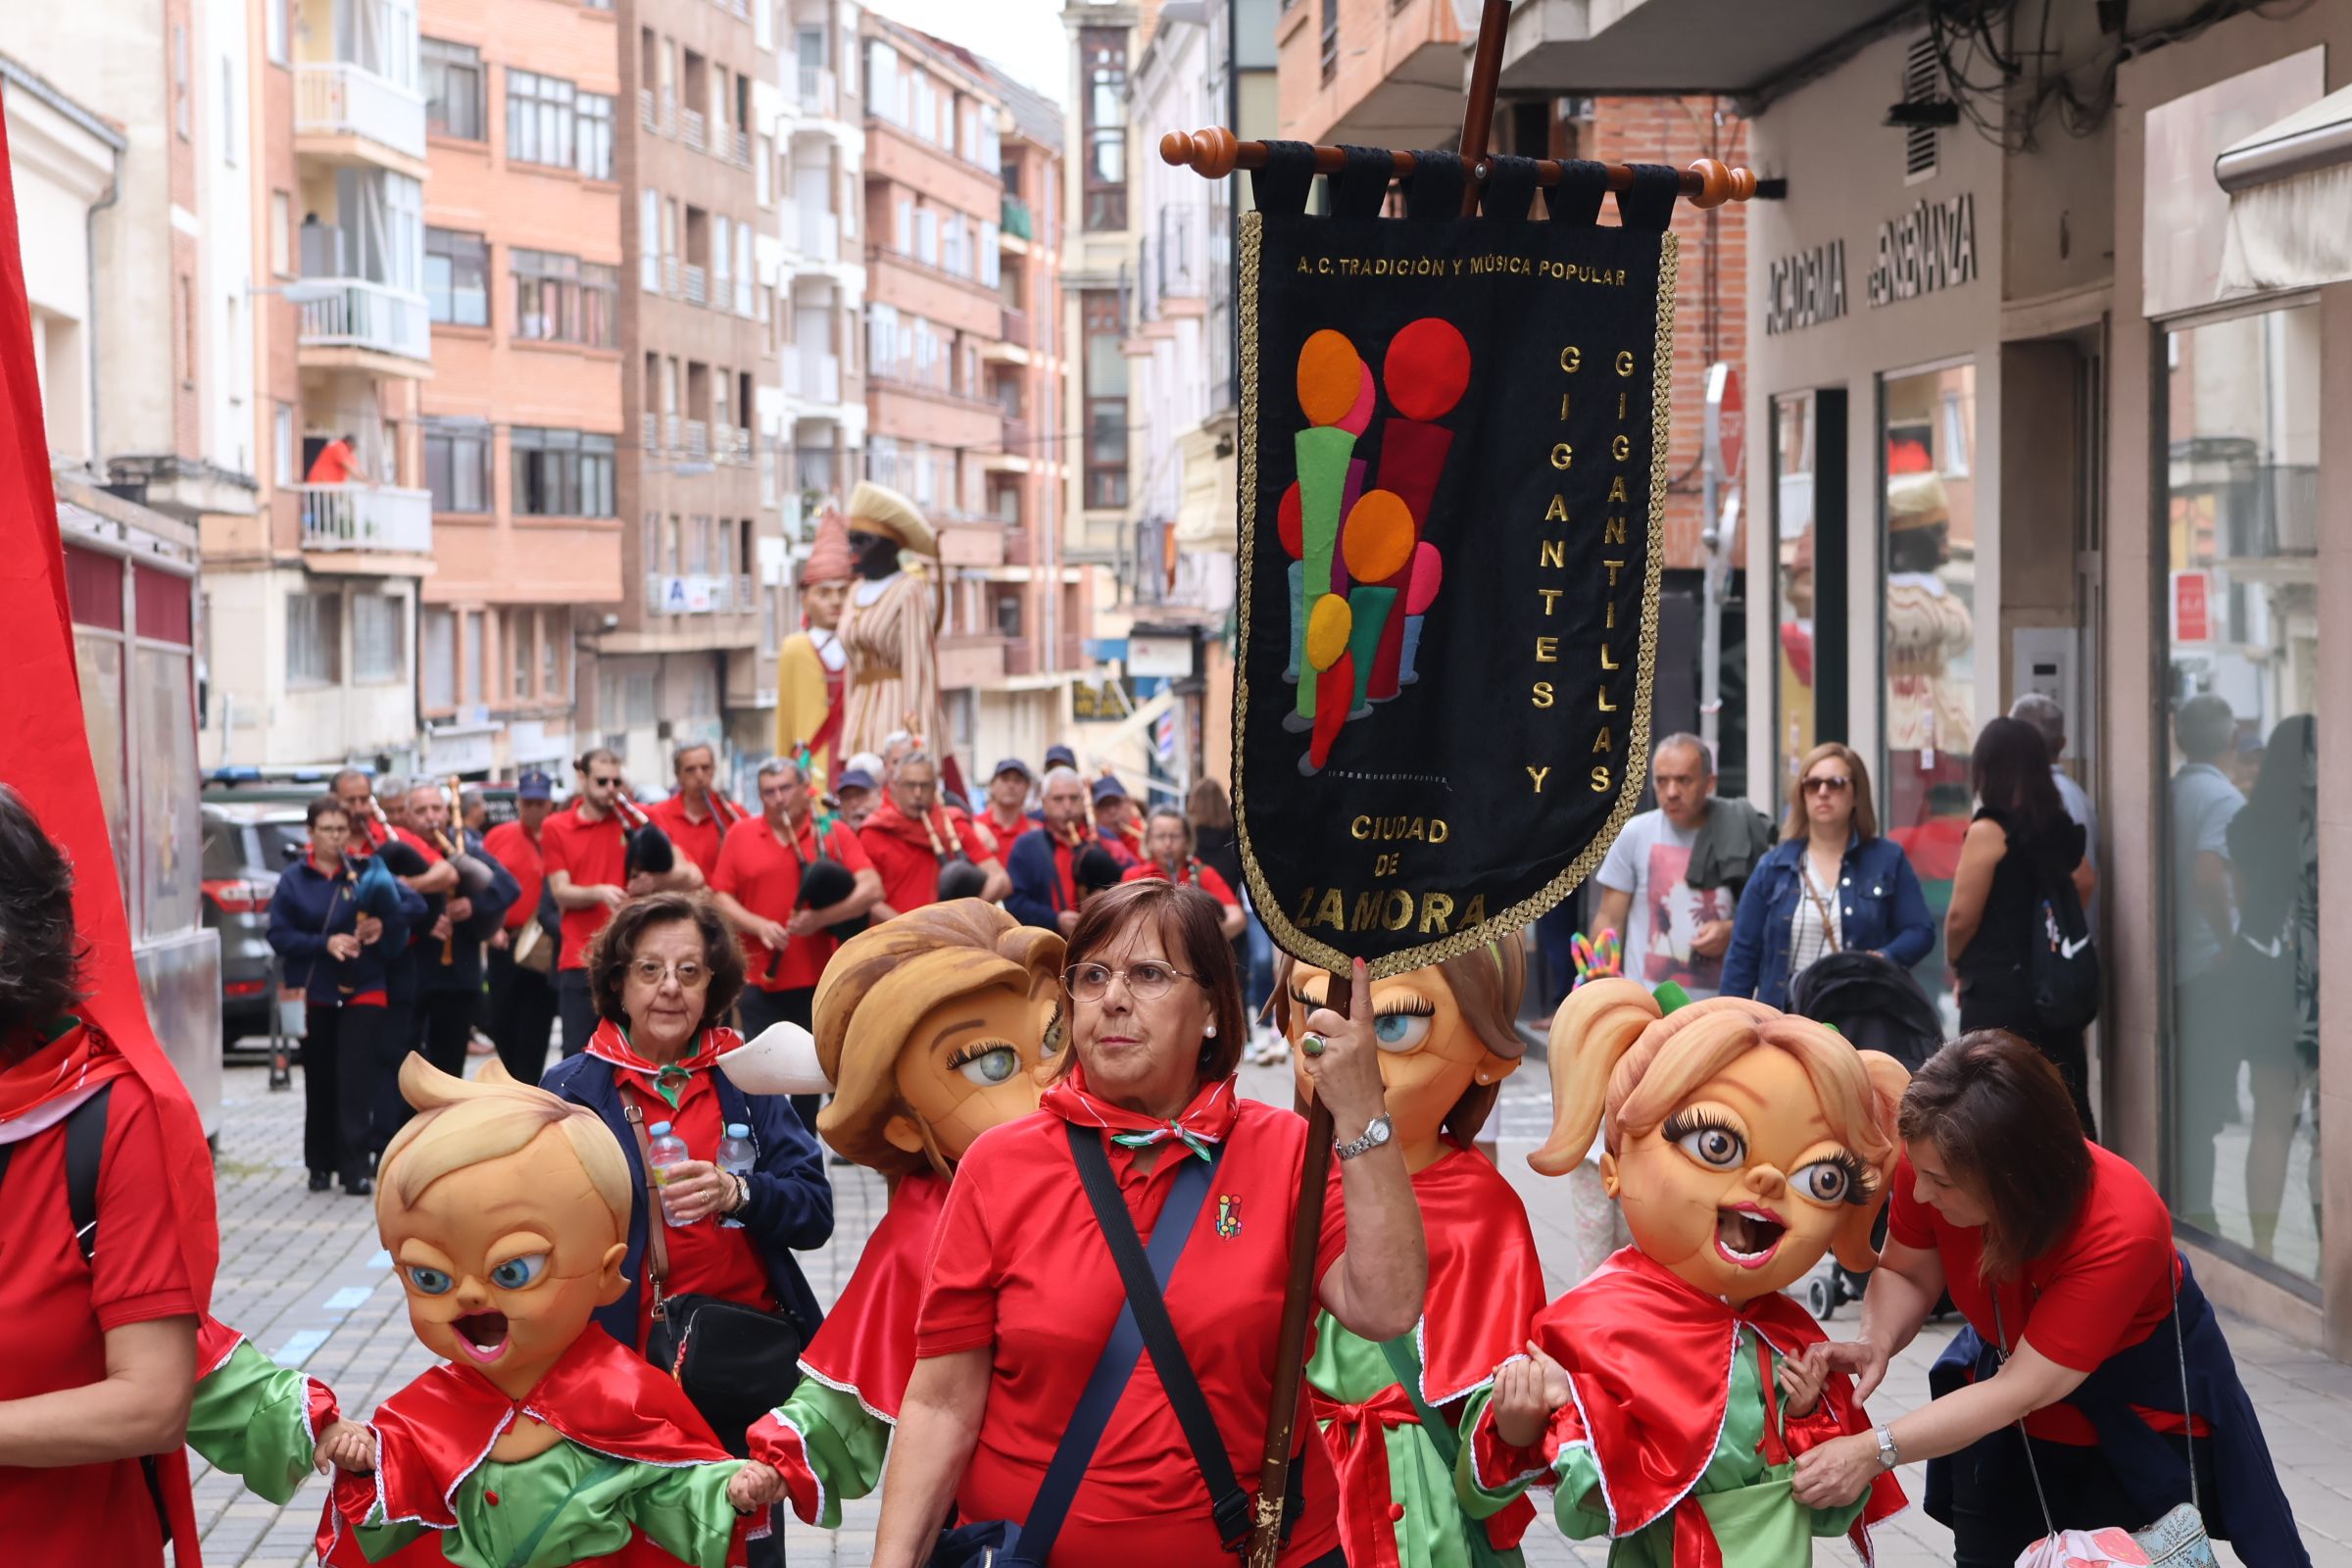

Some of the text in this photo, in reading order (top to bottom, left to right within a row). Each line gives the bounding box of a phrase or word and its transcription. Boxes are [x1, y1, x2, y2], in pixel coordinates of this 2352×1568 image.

[1452, 259, 1463, 275] Y
[1470, 253, 1532, 275] MÚSICA
[1539, 259, 1627, 286] POPULAR
[1766, 236, 1848, 336] ACADEMIA
[1526, 346, 1582, 794] GIGANTES Y
[1590, 350, 1635, 793] GIGANTILLAS
[1350, 814, 1449, 844] CIUDAD
[1374, 853, 1400, 877] DE
[1294, 886, 1486, 933] ZAMORA
